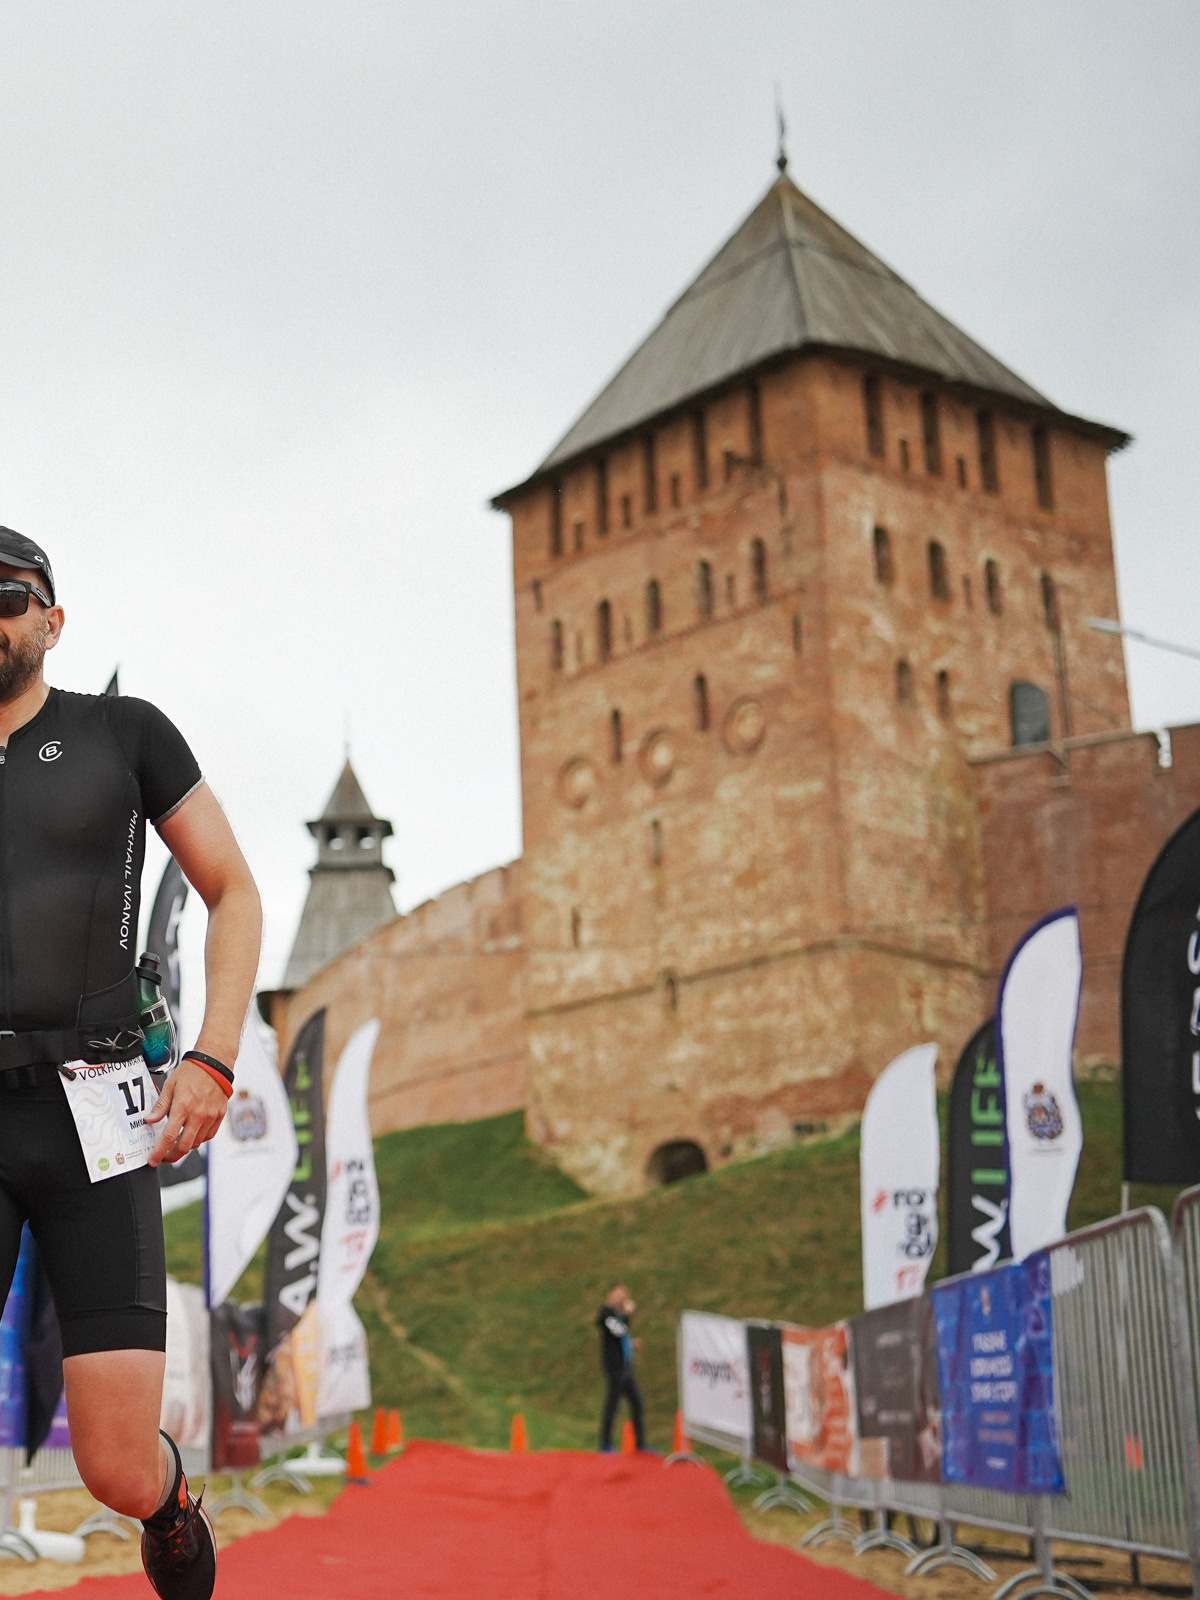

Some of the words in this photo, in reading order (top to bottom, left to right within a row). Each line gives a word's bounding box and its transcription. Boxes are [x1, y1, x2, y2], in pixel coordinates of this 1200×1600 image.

[124, 809, 139, 880] MIKHAIL
[119, 884, 132, 950] IVANOV
[117, 1075, 145, 1117] 17
